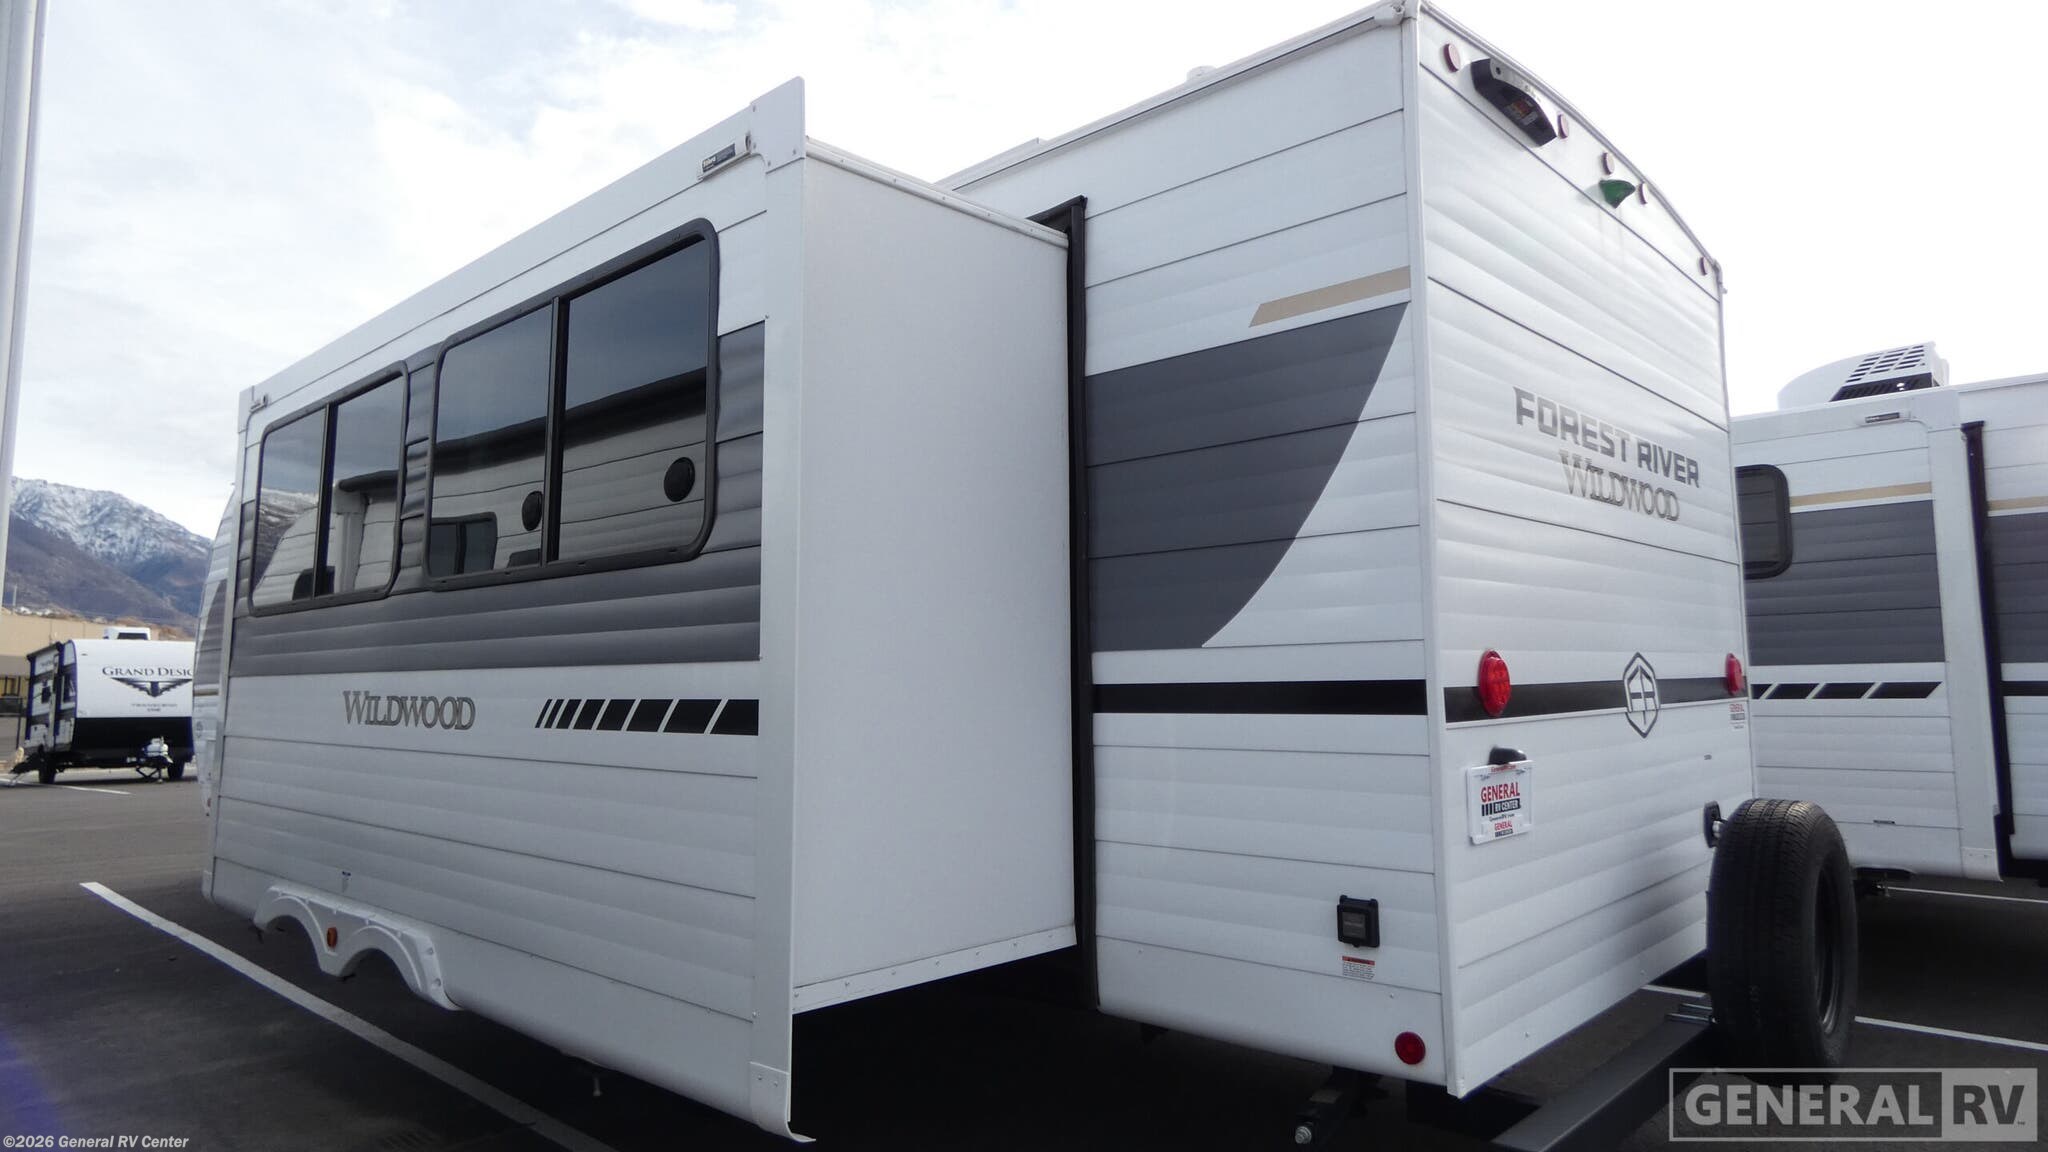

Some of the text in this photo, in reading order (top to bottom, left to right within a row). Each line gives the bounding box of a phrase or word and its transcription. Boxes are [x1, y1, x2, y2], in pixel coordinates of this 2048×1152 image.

[1513, 386, 1700, 488] FOREST RIVER
[1559, 449, 1681, 522] WILDWOOD
[102, 667, 154, 676] GRAND
[342, 690, 476, 730] WILDWOOD
[1481, 782, 1520, 803] GENERAL
